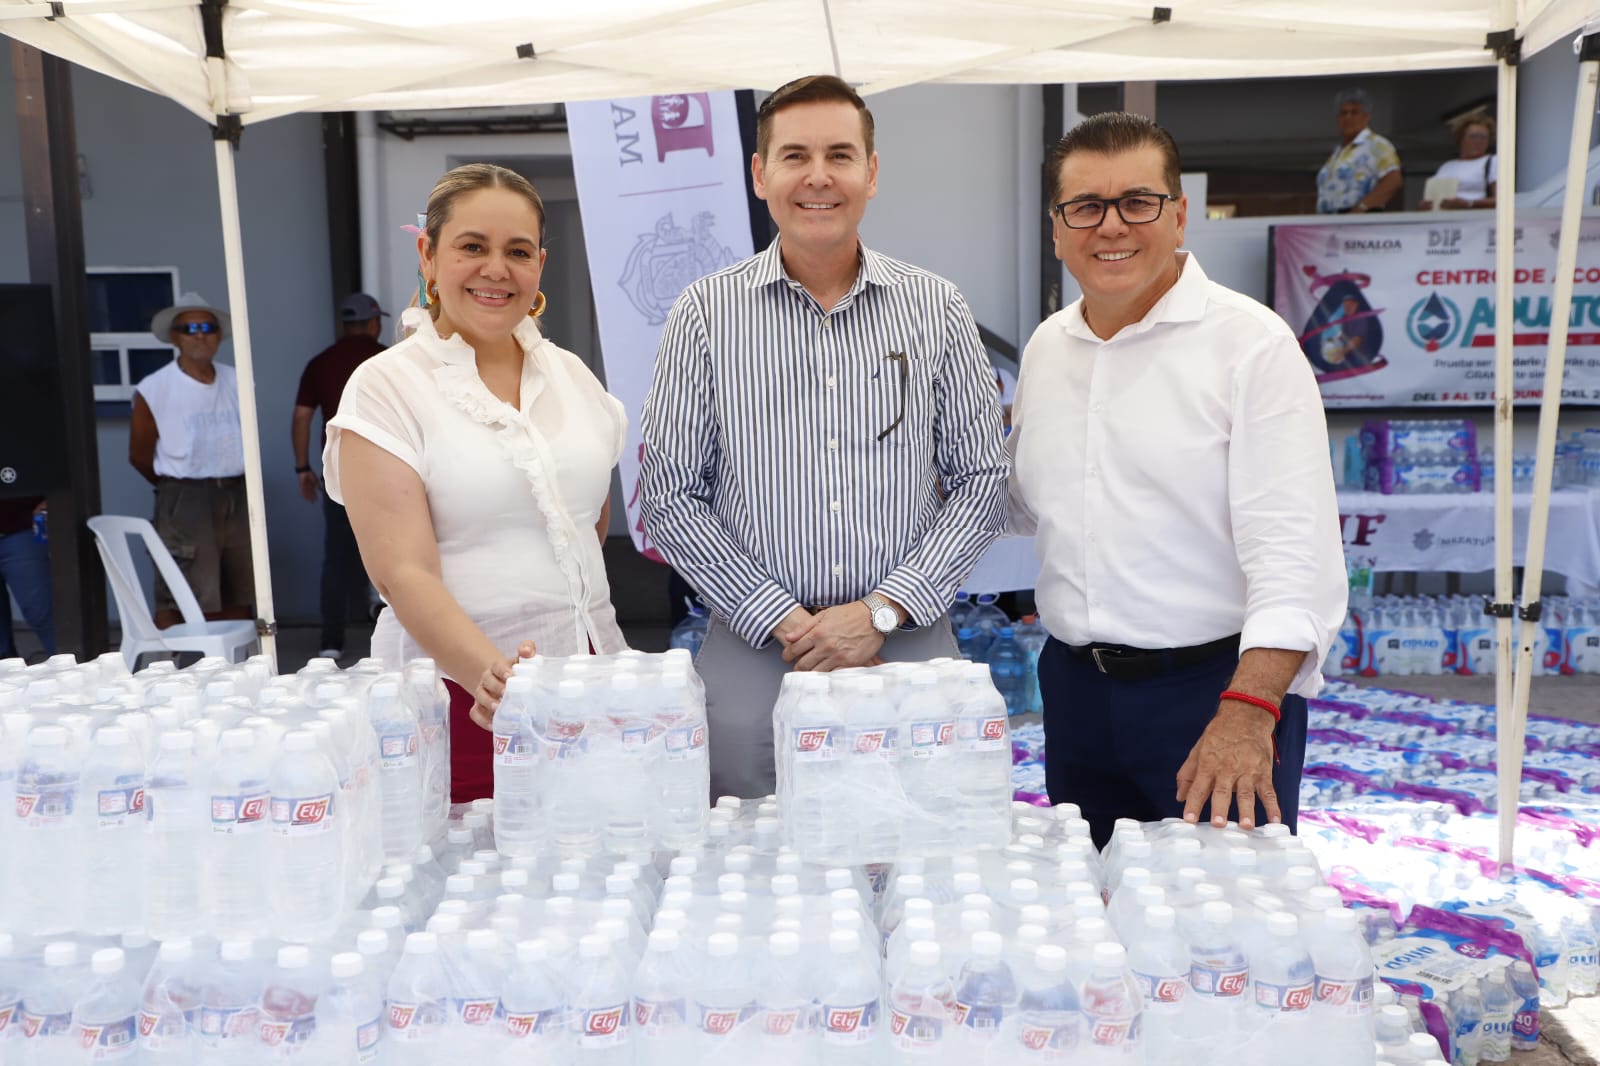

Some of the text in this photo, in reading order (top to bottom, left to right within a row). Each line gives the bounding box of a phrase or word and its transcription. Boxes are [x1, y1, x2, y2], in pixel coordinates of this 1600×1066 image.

[1343, 239, 1402, 250] SINALOA
[1514, 268, 1546, 285] DE
[801, 733, 822, 749] Ely
[299, 803, 325, 821] Ely
[1223, 976, 1245, 993] Ely
[1289, 992, 1311, 1008] Ely
[391, 1006, 410, 1026] Ely
[465, 1005, 493, 1021] Ely
[509, 1018, 531, 1035] Ely
[592, 1014, 616, 1033] Ely
[708, 1015, 733, 1033] Ely
[833, 1014, 858, 1031] Ely
[1099, 1025, 1125, 1043] Ely
